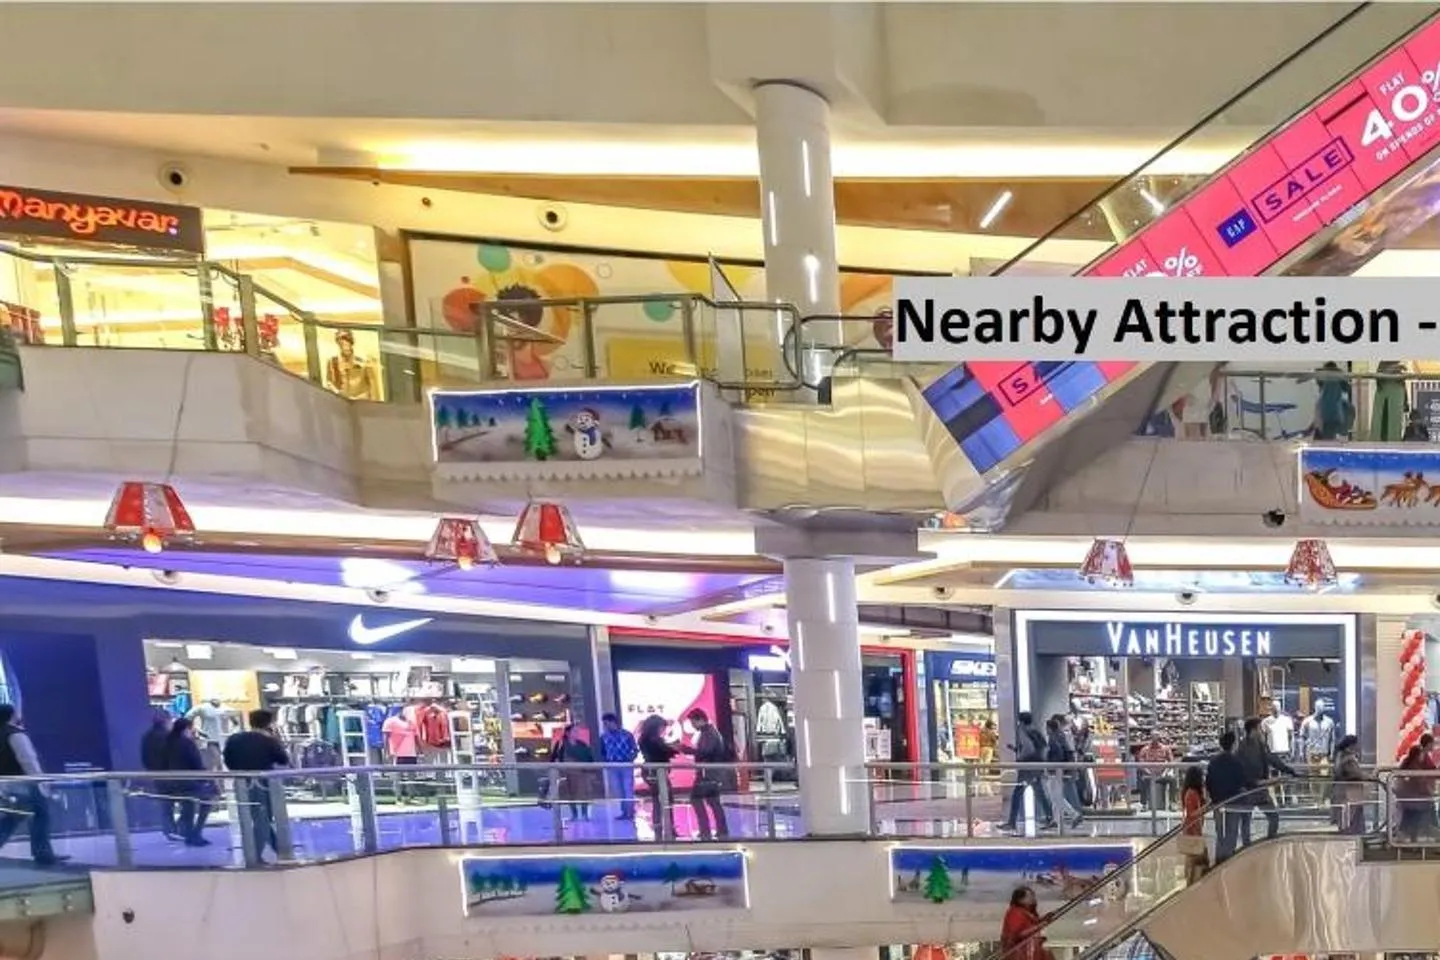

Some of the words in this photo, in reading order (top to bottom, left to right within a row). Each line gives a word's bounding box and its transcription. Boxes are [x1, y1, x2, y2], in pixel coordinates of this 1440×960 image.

[1379, 73, 1405, 96] FLAT
[1265, 148, 1344, 211] SALE
[627, 703, 665, 714] FLAT
